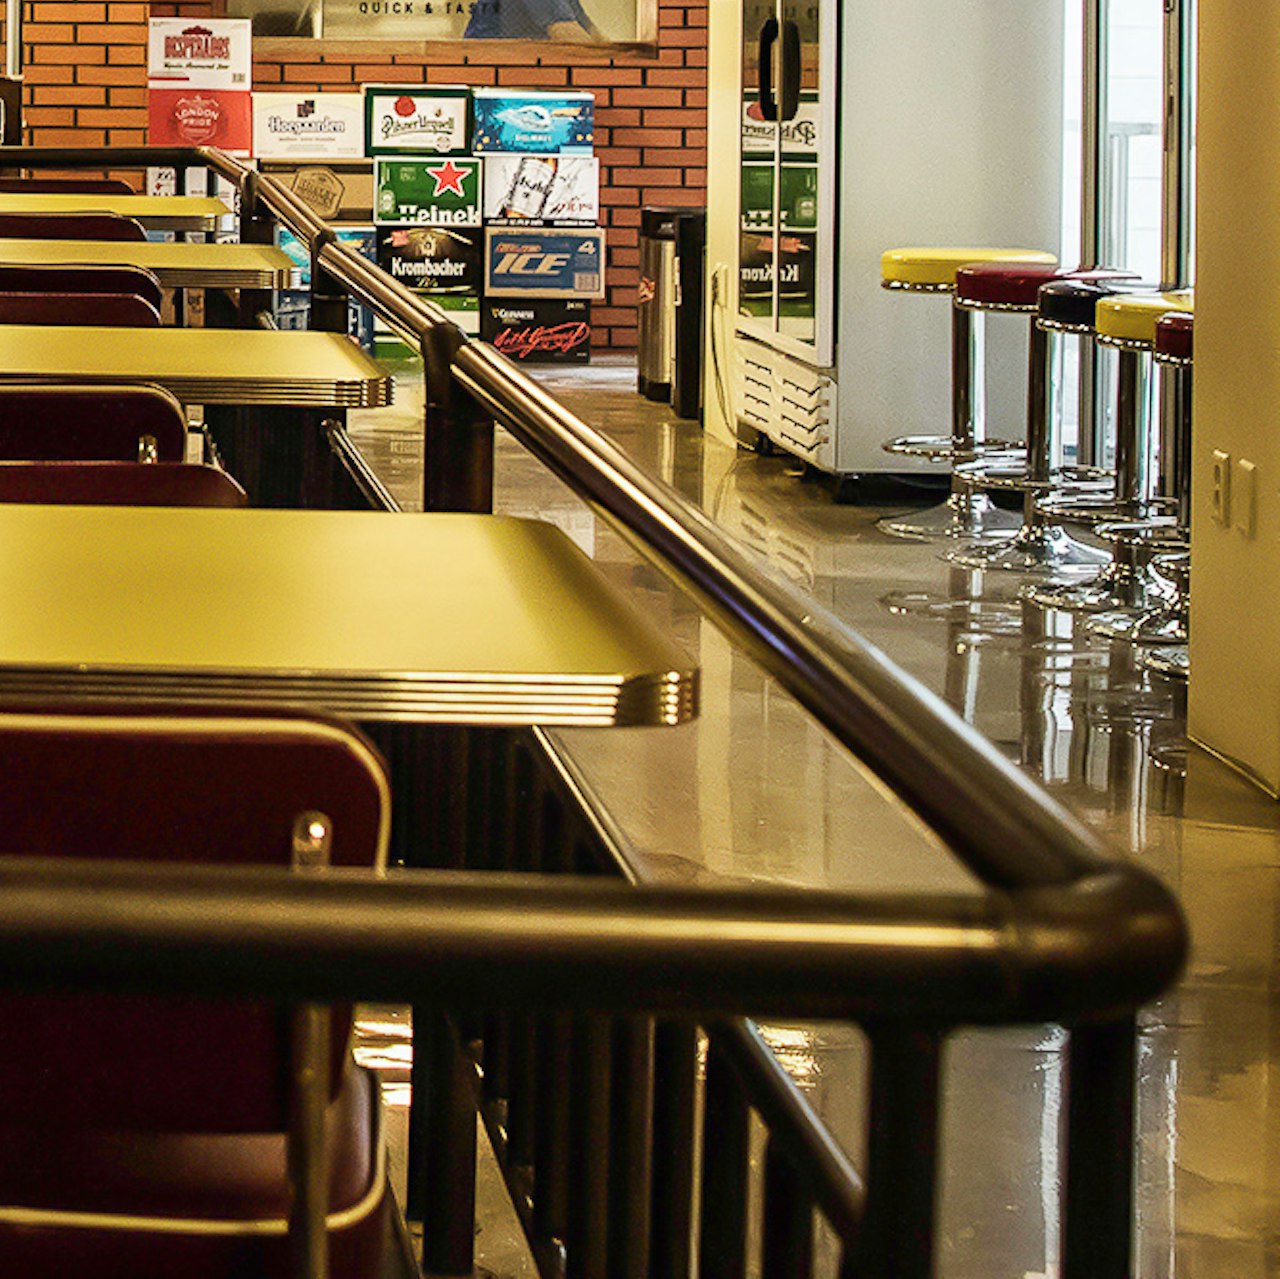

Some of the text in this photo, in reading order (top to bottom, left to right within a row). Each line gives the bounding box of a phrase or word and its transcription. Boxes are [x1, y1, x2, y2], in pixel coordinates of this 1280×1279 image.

[359, 2, 413, 14] QUICK
[425, 2, 433, 14] &
[175, 107, 219, 120] LONDON
[268, 115, 346, 135] Hoegaarden
[577, 240, 596, 254] 4
[391, 256, 467, 276] Krombacher
[493, 253, 572, 275] ICE
